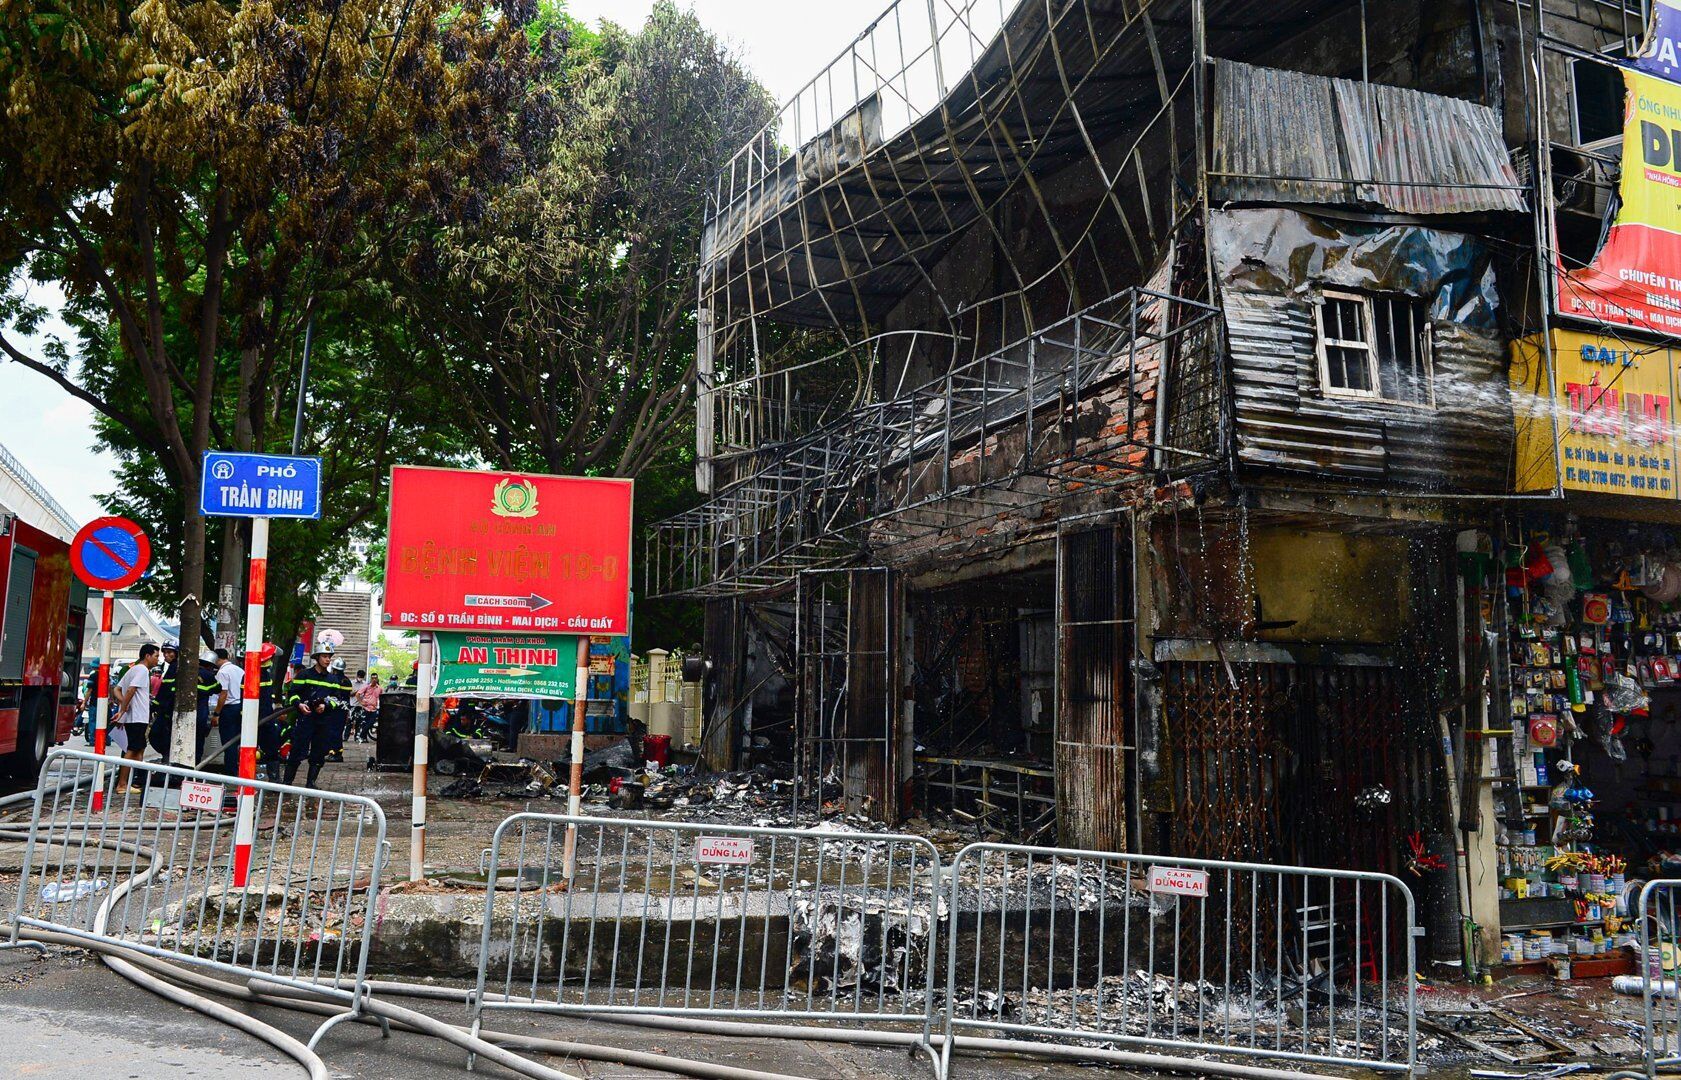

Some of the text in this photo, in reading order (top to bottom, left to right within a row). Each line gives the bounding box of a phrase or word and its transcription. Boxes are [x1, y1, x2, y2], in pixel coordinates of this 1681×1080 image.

[1638, 94, 1661, 116] ỐNG
[1619, 268, 1666, 289] CHUYÊN
[1598, 303, 1602, 312] 1
[1650, 313, 1664, 324] MAI
[257, 463, 297, 478] PHỐ
[220, 480, 304, 510] TRẦN BÌNH
[536, 523, 557, 537] AN
[401, 540, 477, 580] BỆNH
[487, 544, 551, 583] VIỆN
[477, 597, 526, 607] CÁCH 500m
[400, 612, 418, 623] ĐC:
[421, 610, 436, 624] SỐ
[438, 614, 445, 623] 9
[477, 613, 503, 626] BÌNH
[512, 616, 532, 627] MAI
[534, 618, 558, 629] DỊCH
[590, 616, 613, 629] GIẤY
[457, 646, 558, 669] AN THỊNH
[193, 785, 210, 793] POLICE
[188, 793, 212, 804] STOP
[702, 845, 748, 859] DỪNG LẠI
[1155, 876, 1203, 891] DỪNG LẠI
